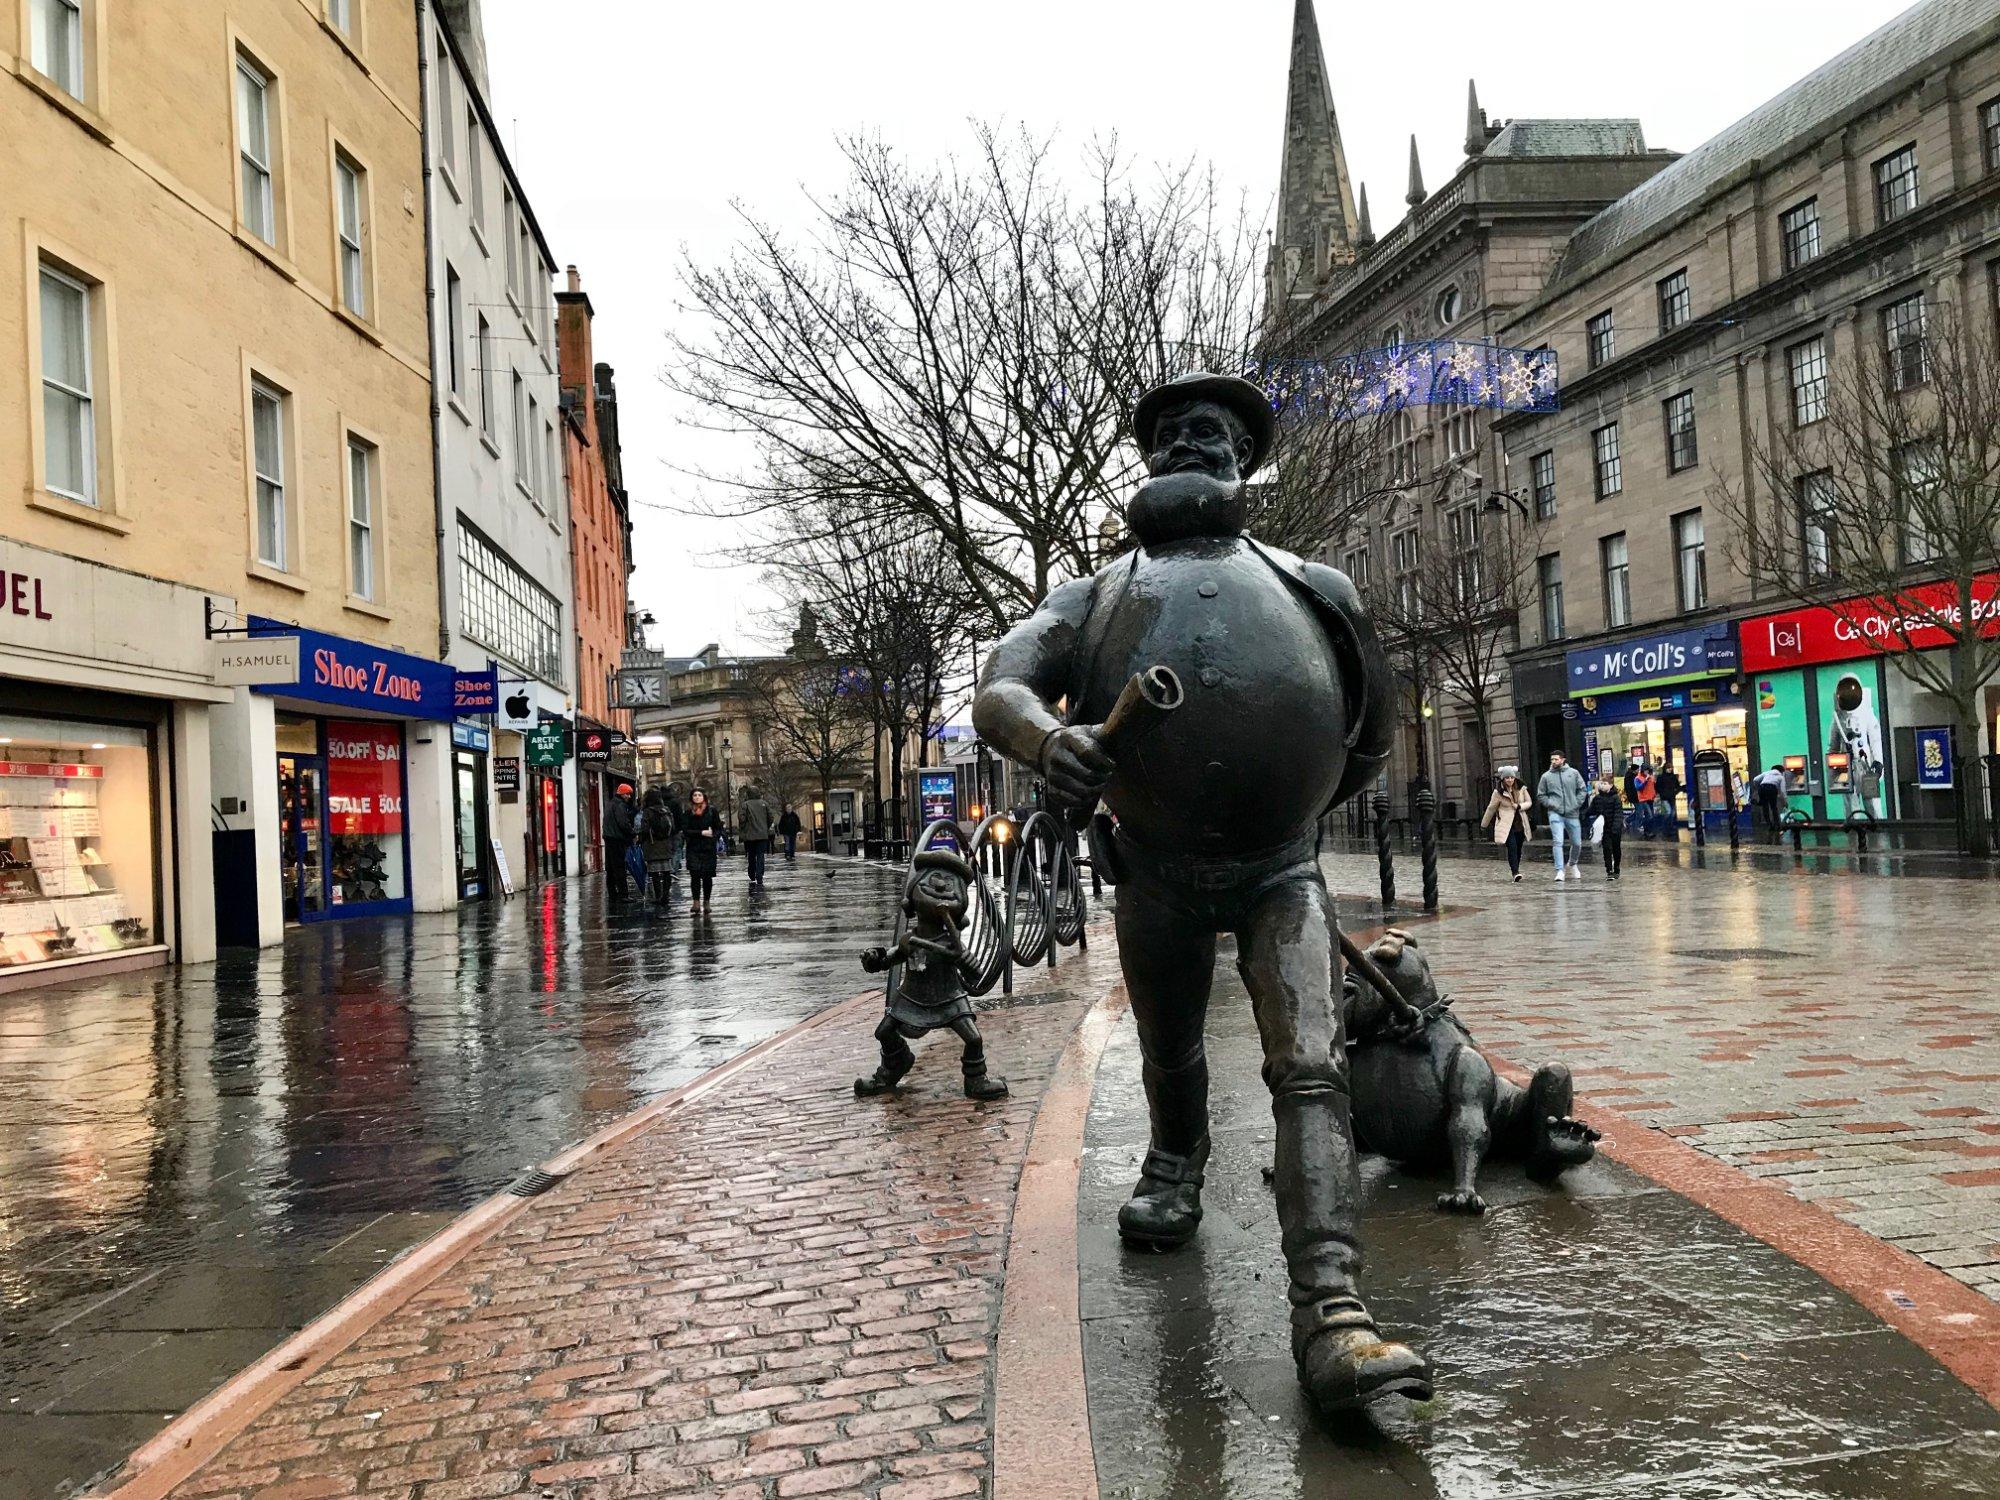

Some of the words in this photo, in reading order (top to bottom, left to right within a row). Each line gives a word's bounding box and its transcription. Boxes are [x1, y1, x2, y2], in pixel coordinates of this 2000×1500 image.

[222, 655, 291, 667] H.SAMUEL
[314, 648, 368, 692] Shoe
[373, 661, 422, 702] Zone
[454, 680, 492, 692] Shoe
[454, 693, 493, 706] Zone
[531, 735, 560, 744] ARCTIC
[537, 742, 554, 750] BAR
[580, 752, 608, 760] money
[1925, 770, 1944, 778] bright
[329, 796, 372, 813] SALE
